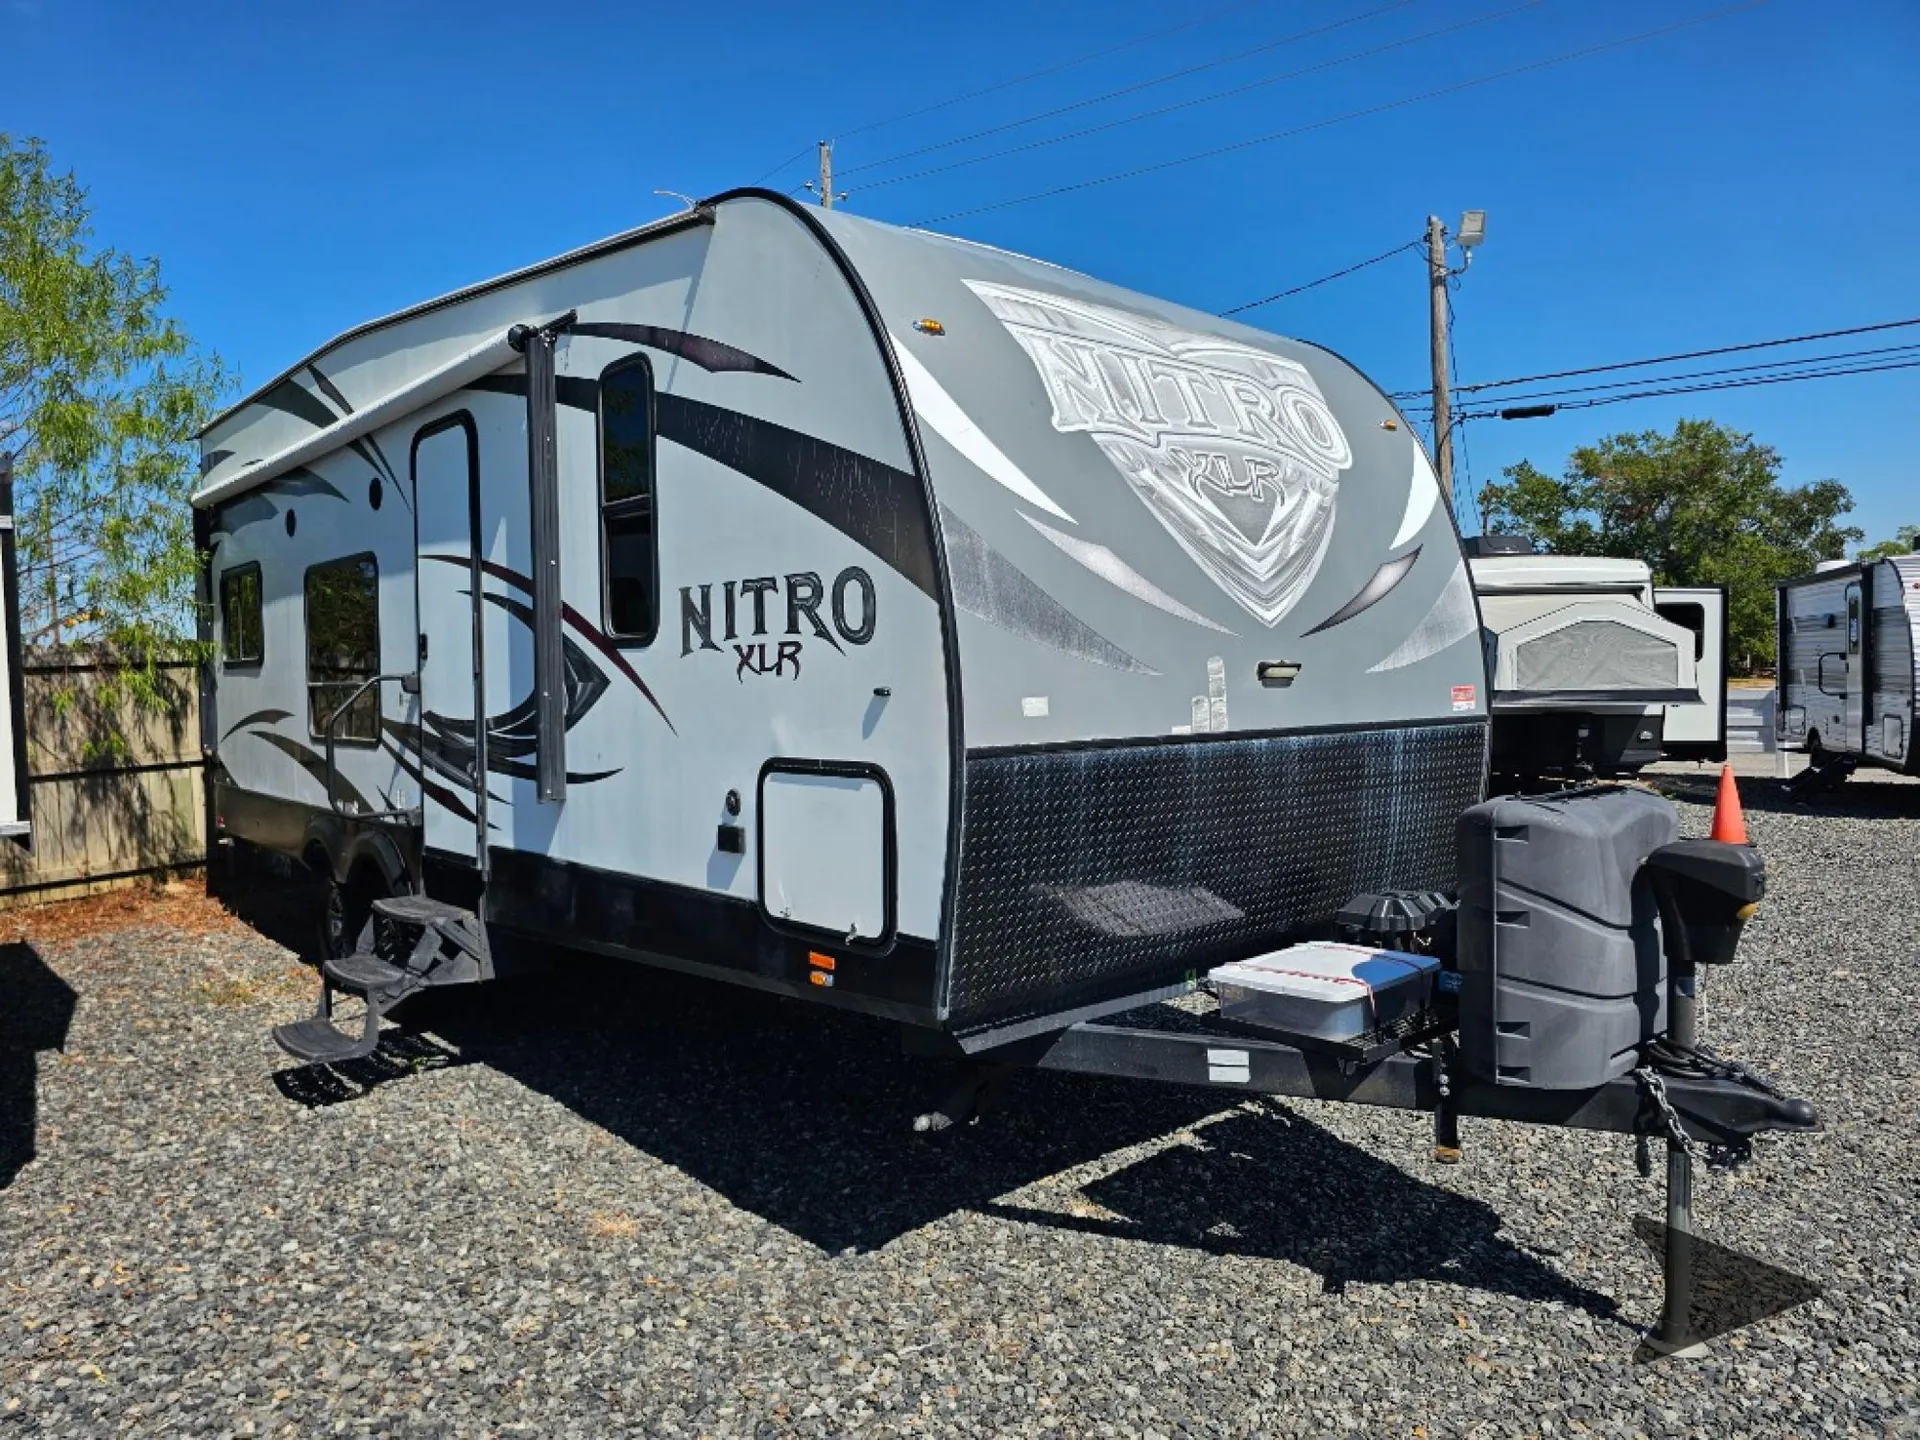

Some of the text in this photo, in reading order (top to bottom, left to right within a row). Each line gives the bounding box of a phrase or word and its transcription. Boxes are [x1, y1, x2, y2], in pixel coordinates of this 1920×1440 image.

[1022, 331, 1350, 480] NITRO
[1167, 448, 1285, 507] XLR
[679, 565, 876, 658] NITRO
[733, 641, 803, 684] XLR
